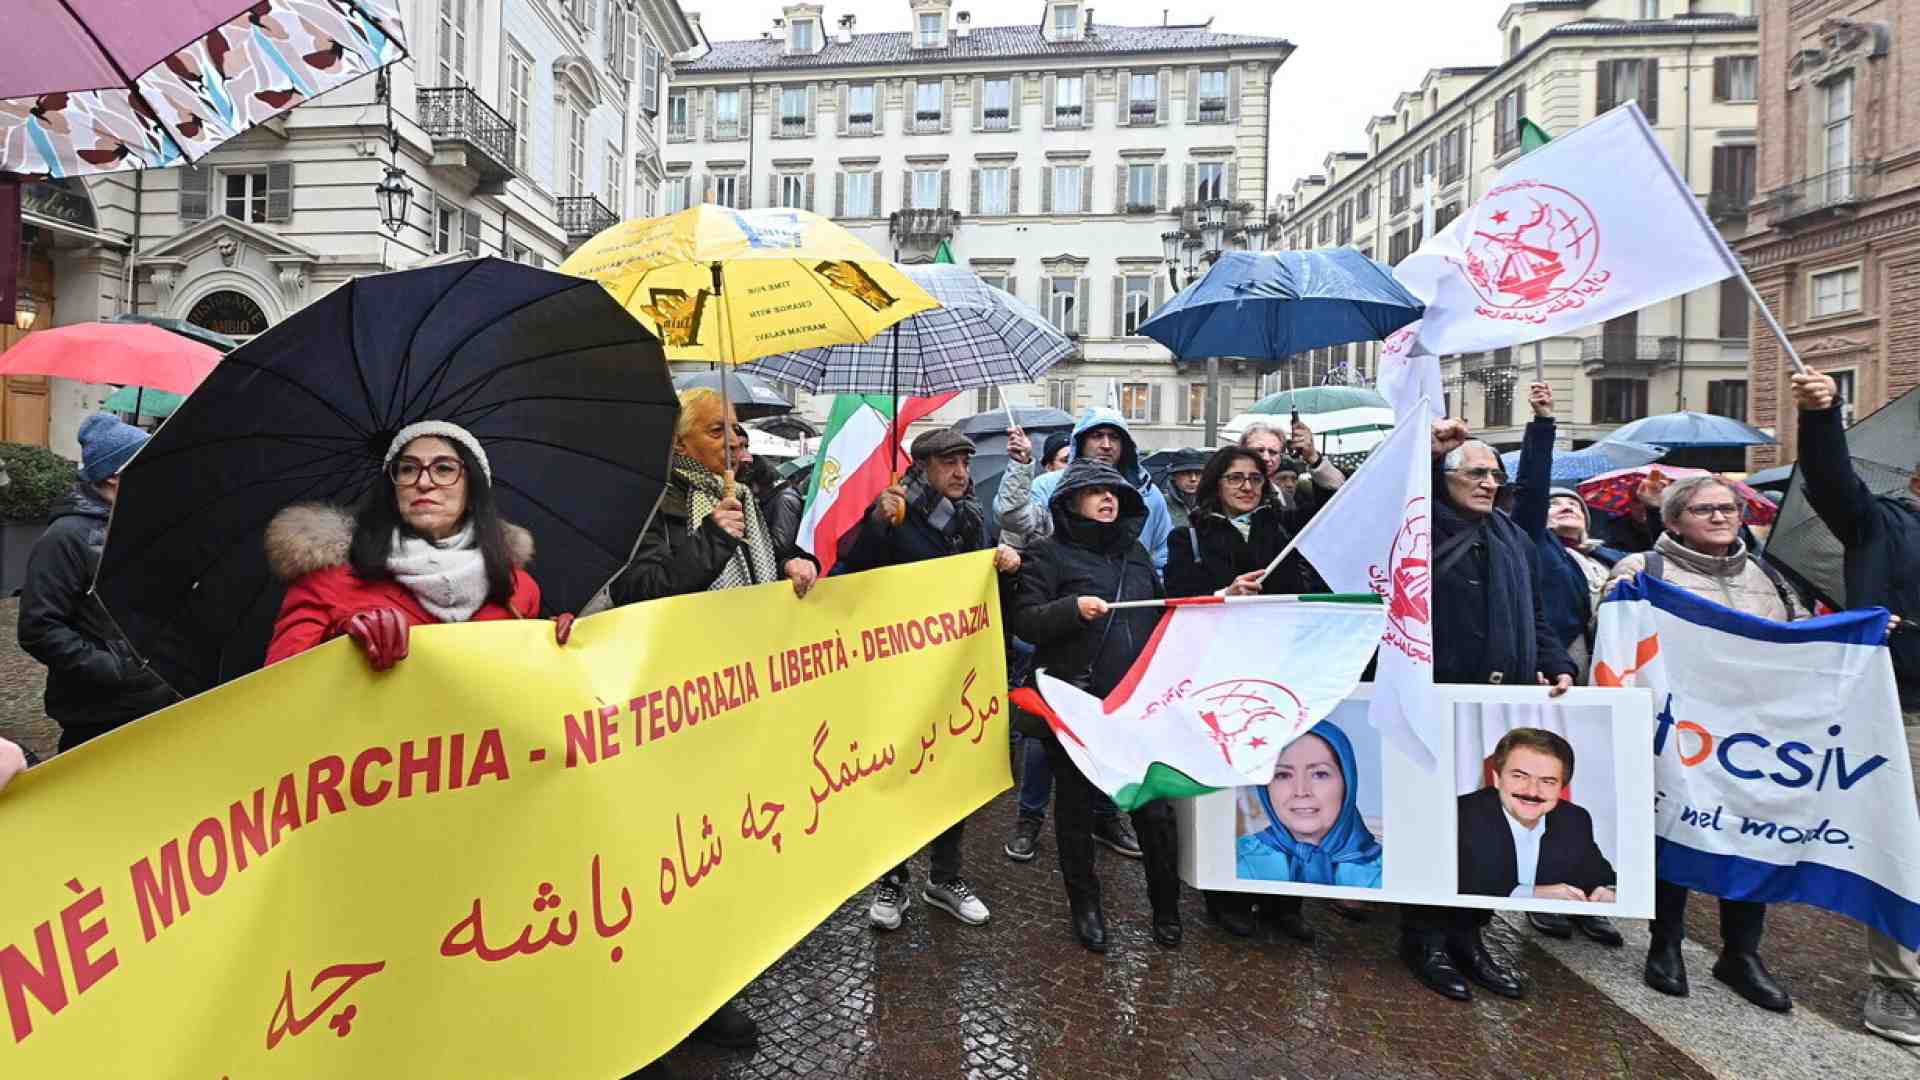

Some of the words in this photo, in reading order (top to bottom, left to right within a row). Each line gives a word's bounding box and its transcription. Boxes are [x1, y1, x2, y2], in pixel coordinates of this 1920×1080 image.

[910, 722, 937, 774] بر
[949, 667, 999, 744] مرگ
[0, 876, 120, 1044] NÈ
[130, 727, 511, 944] MONARCHIA
[563, 696, 621, 769] NÈ
[629, 661, 760, 747] TEOCRAZIA
[768, 629, 849, 693] LIBERTÀ
[861, 601, 990, 663] DEMOCRAZIA
[741, 792, 785, 853] چه
[804, 719, 895, 835] ستمگر
[1680, 805, 1723, 831] nel
[659, 812, 722, 906] شاه
[439, 853, 633, 963] باشه
[266, 959, 386, 1051] چه
